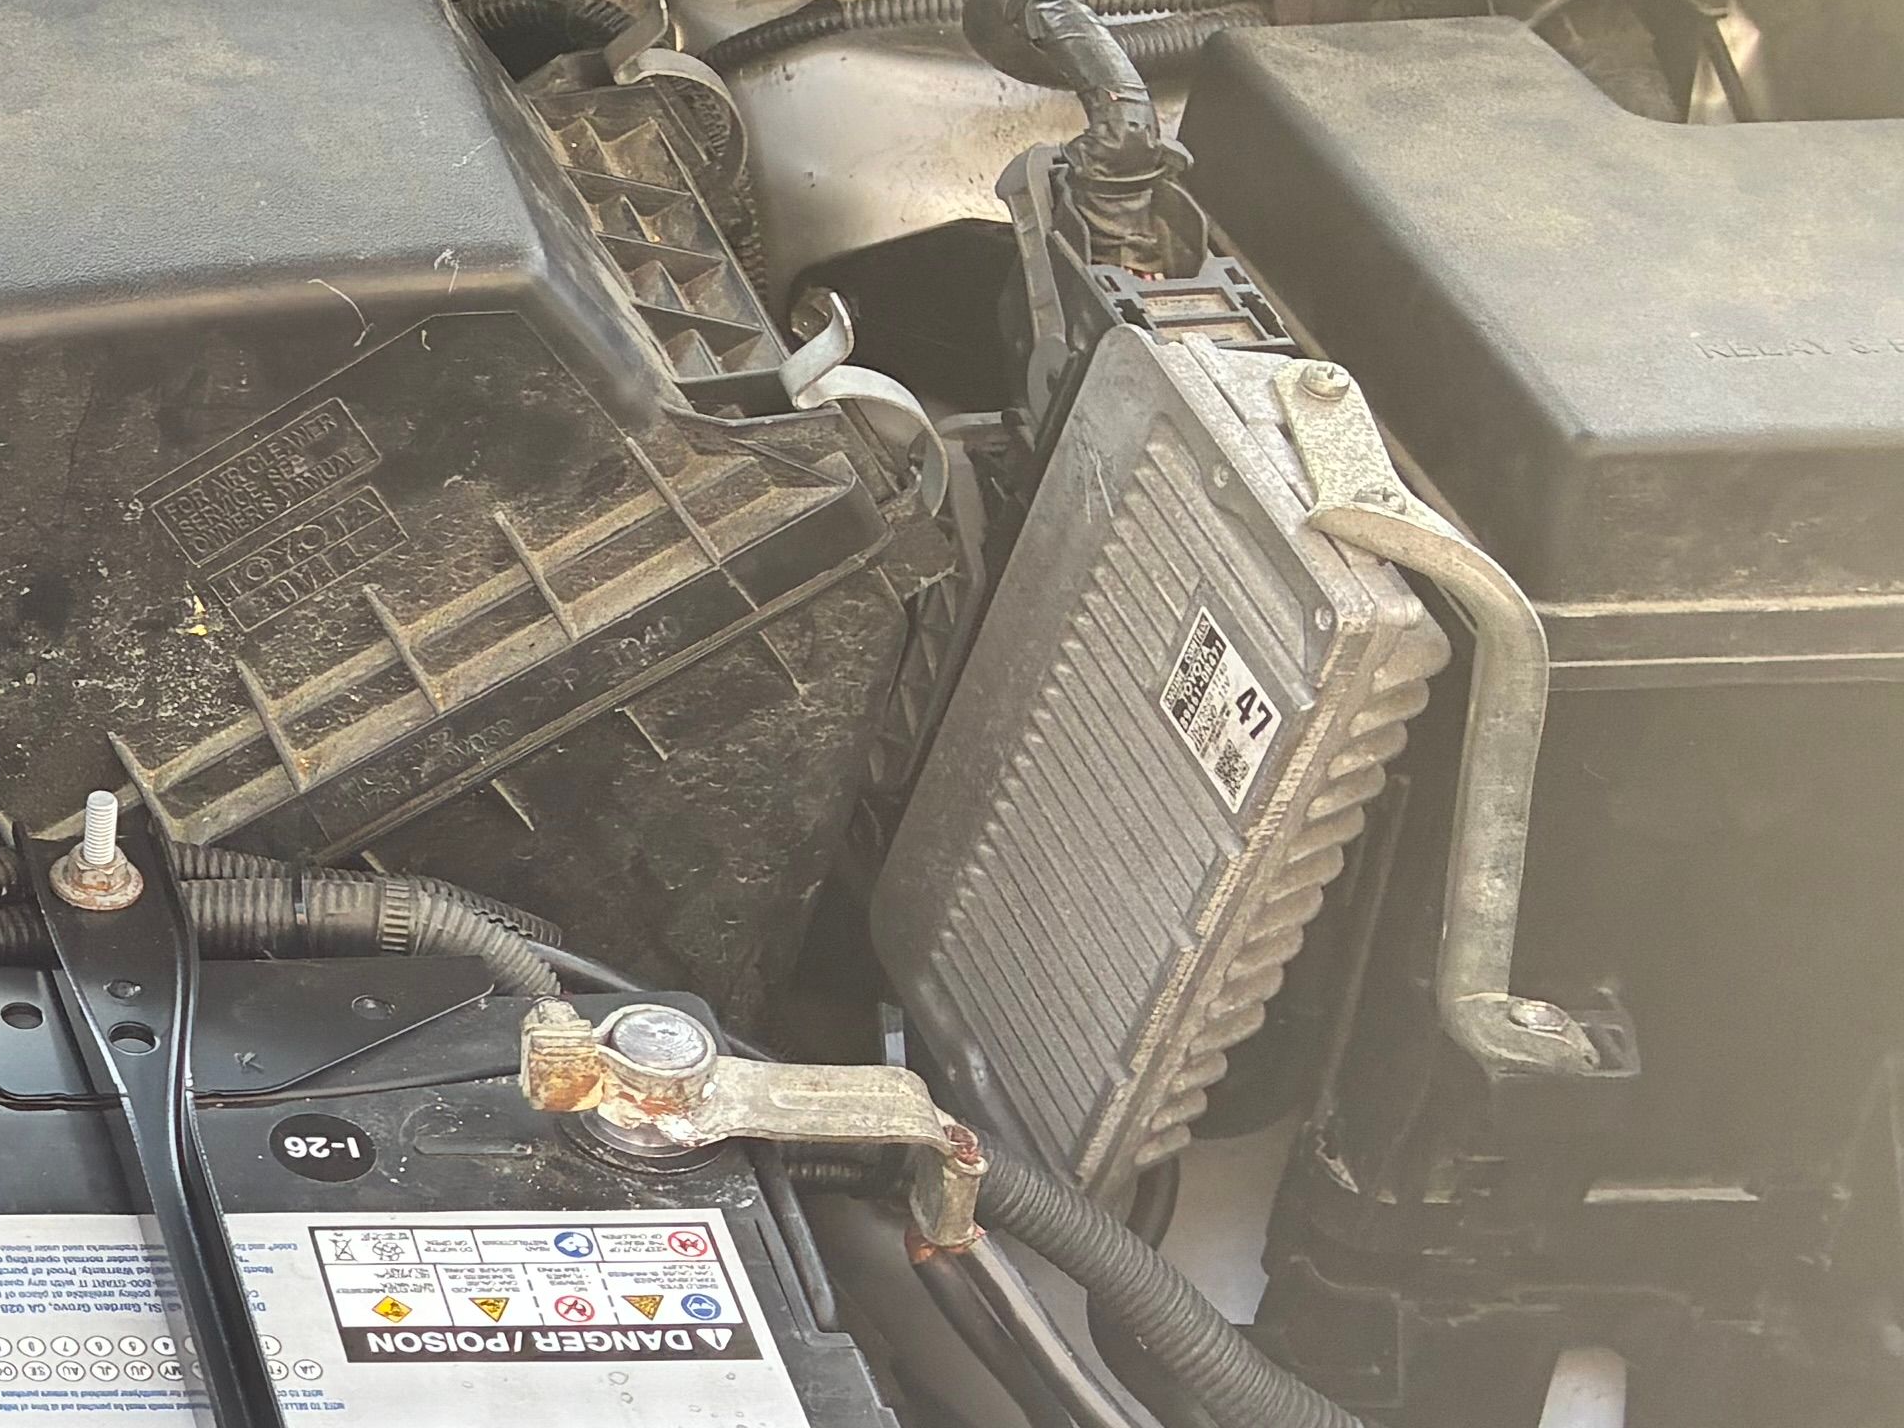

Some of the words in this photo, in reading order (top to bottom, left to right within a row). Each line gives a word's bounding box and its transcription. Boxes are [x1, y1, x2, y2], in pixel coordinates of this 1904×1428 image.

[162, 484, 210, 523] FOR
[1181, 646, 1215, 701] TOYOTA
[1235, 687, 1274, 740] 47
[28, 1303, 45, 1312] CA
[365, 1331, 506, 1353] POISON
[533, 1328, 691, 1350] DANGER
[62, 1341, 68, 1351] 7
[29, 1366, 45, 1375] SE
[62, 1366, 78, 1375] AU
[99, 1366, 111, 1375] JL
[130, 1366, 146, 1375] JU
